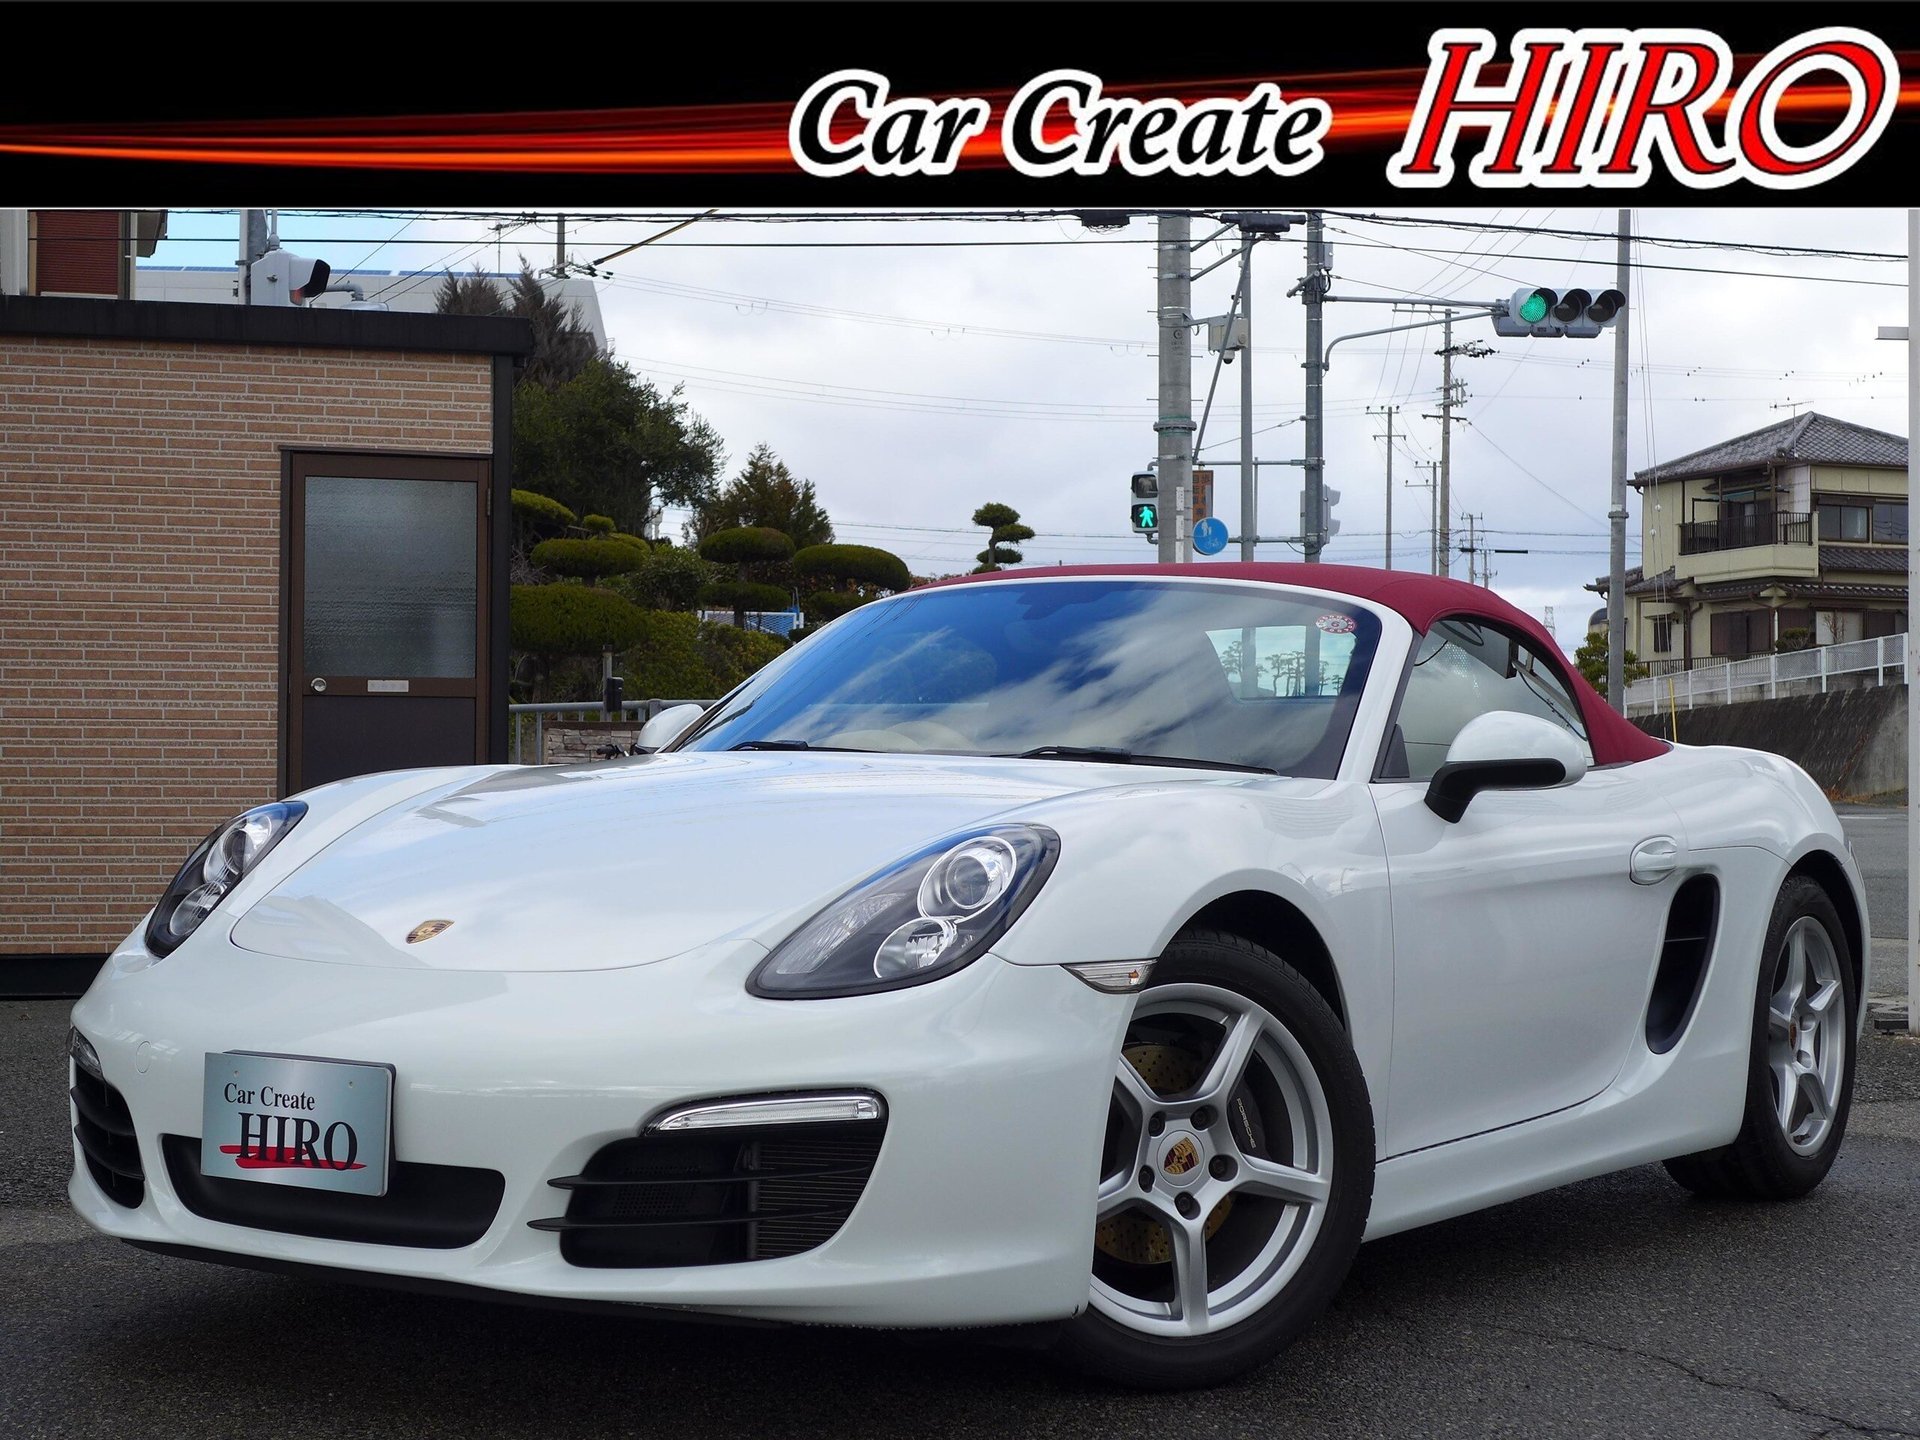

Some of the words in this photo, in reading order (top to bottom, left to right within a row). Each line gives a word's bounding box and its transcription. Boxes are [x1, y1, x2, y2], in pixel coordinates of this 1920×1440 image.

[224, 1082, 255, 1105] Car
[260, 1086, 315, 1110] Create
[238, 1112, 357, 1171] HIRO
[1236, 1097, 1257, 1149] PORSCHE
